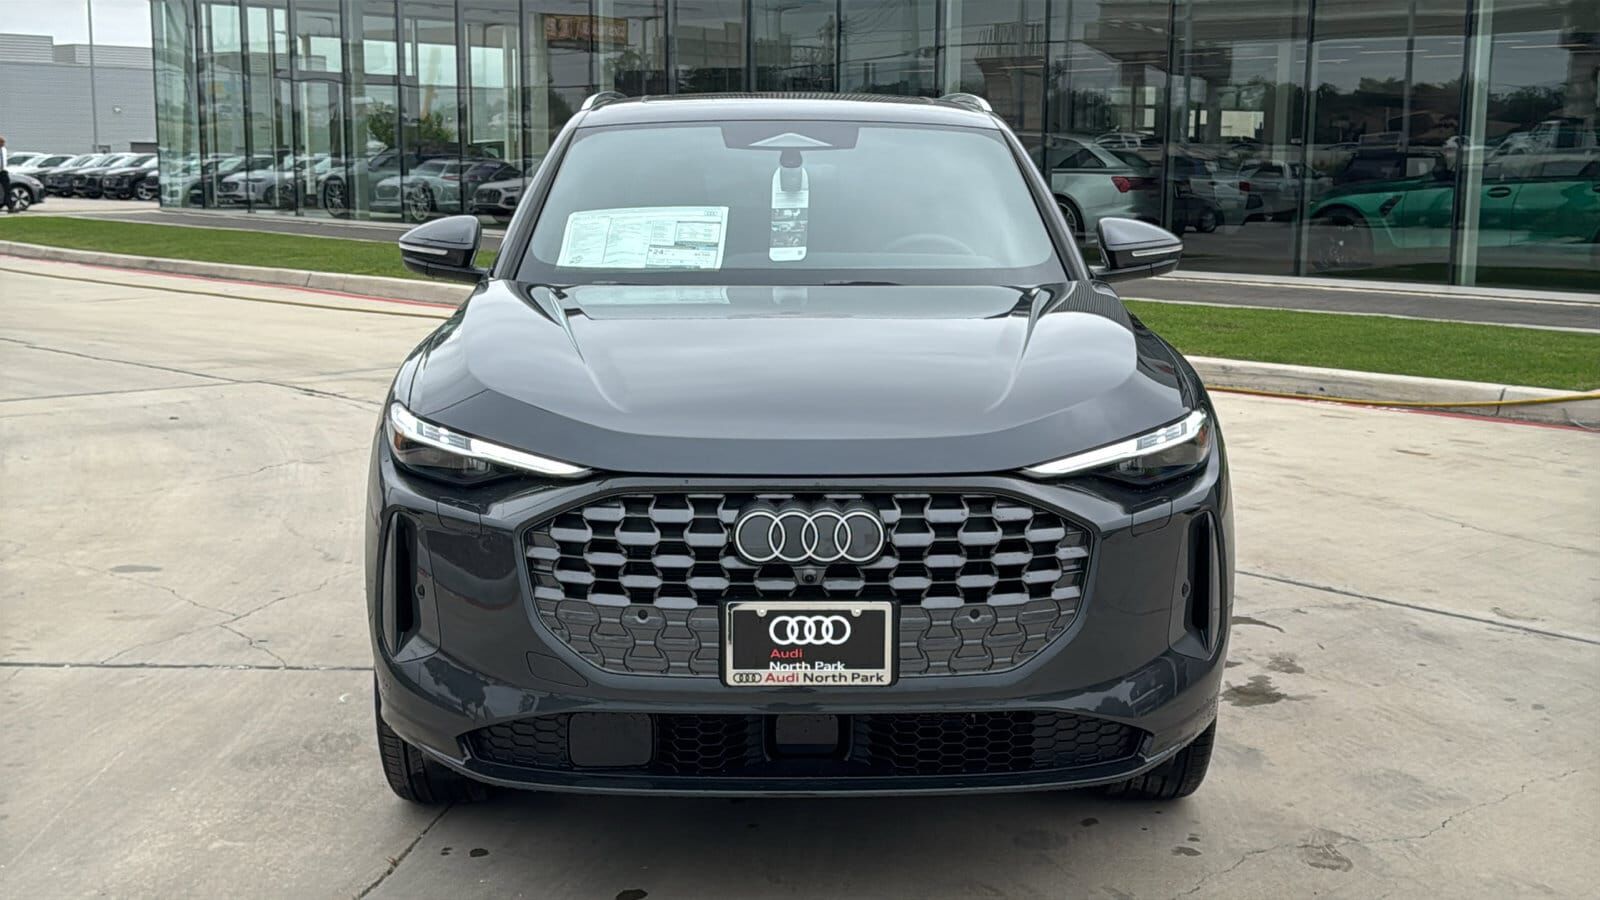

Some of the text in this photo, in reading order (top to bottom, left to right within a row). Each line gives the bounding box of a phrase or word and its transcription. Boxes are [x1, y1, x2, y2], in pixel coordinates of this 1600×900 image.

[770, 648, 804, 659] Audi
[769, 660, 846, 671] North Park
[764, 672, 885, 683] Audi North Park
